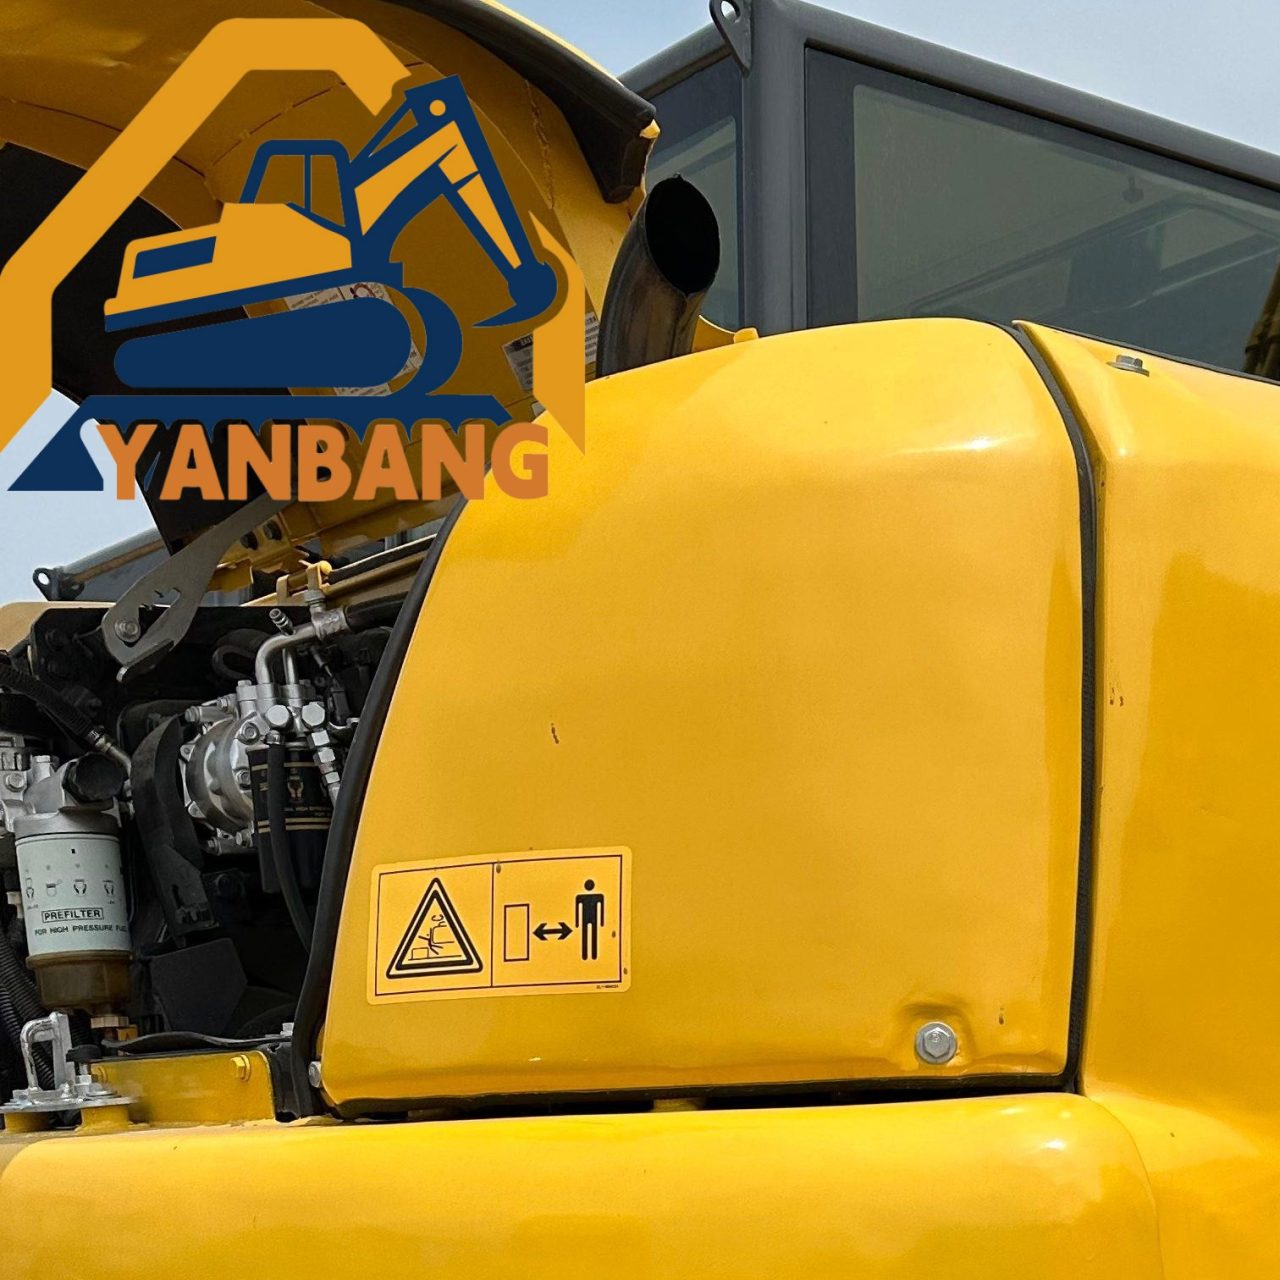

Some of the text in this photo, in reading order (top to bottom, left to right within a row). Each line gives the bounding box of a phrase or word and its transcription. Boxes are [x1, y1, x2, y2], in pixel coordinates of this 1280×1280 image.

[44, 908, 101, 921] PREFILTER
[34, 928, 47, 936] FOR
[73, 924, 113, 932] PRESSURE
